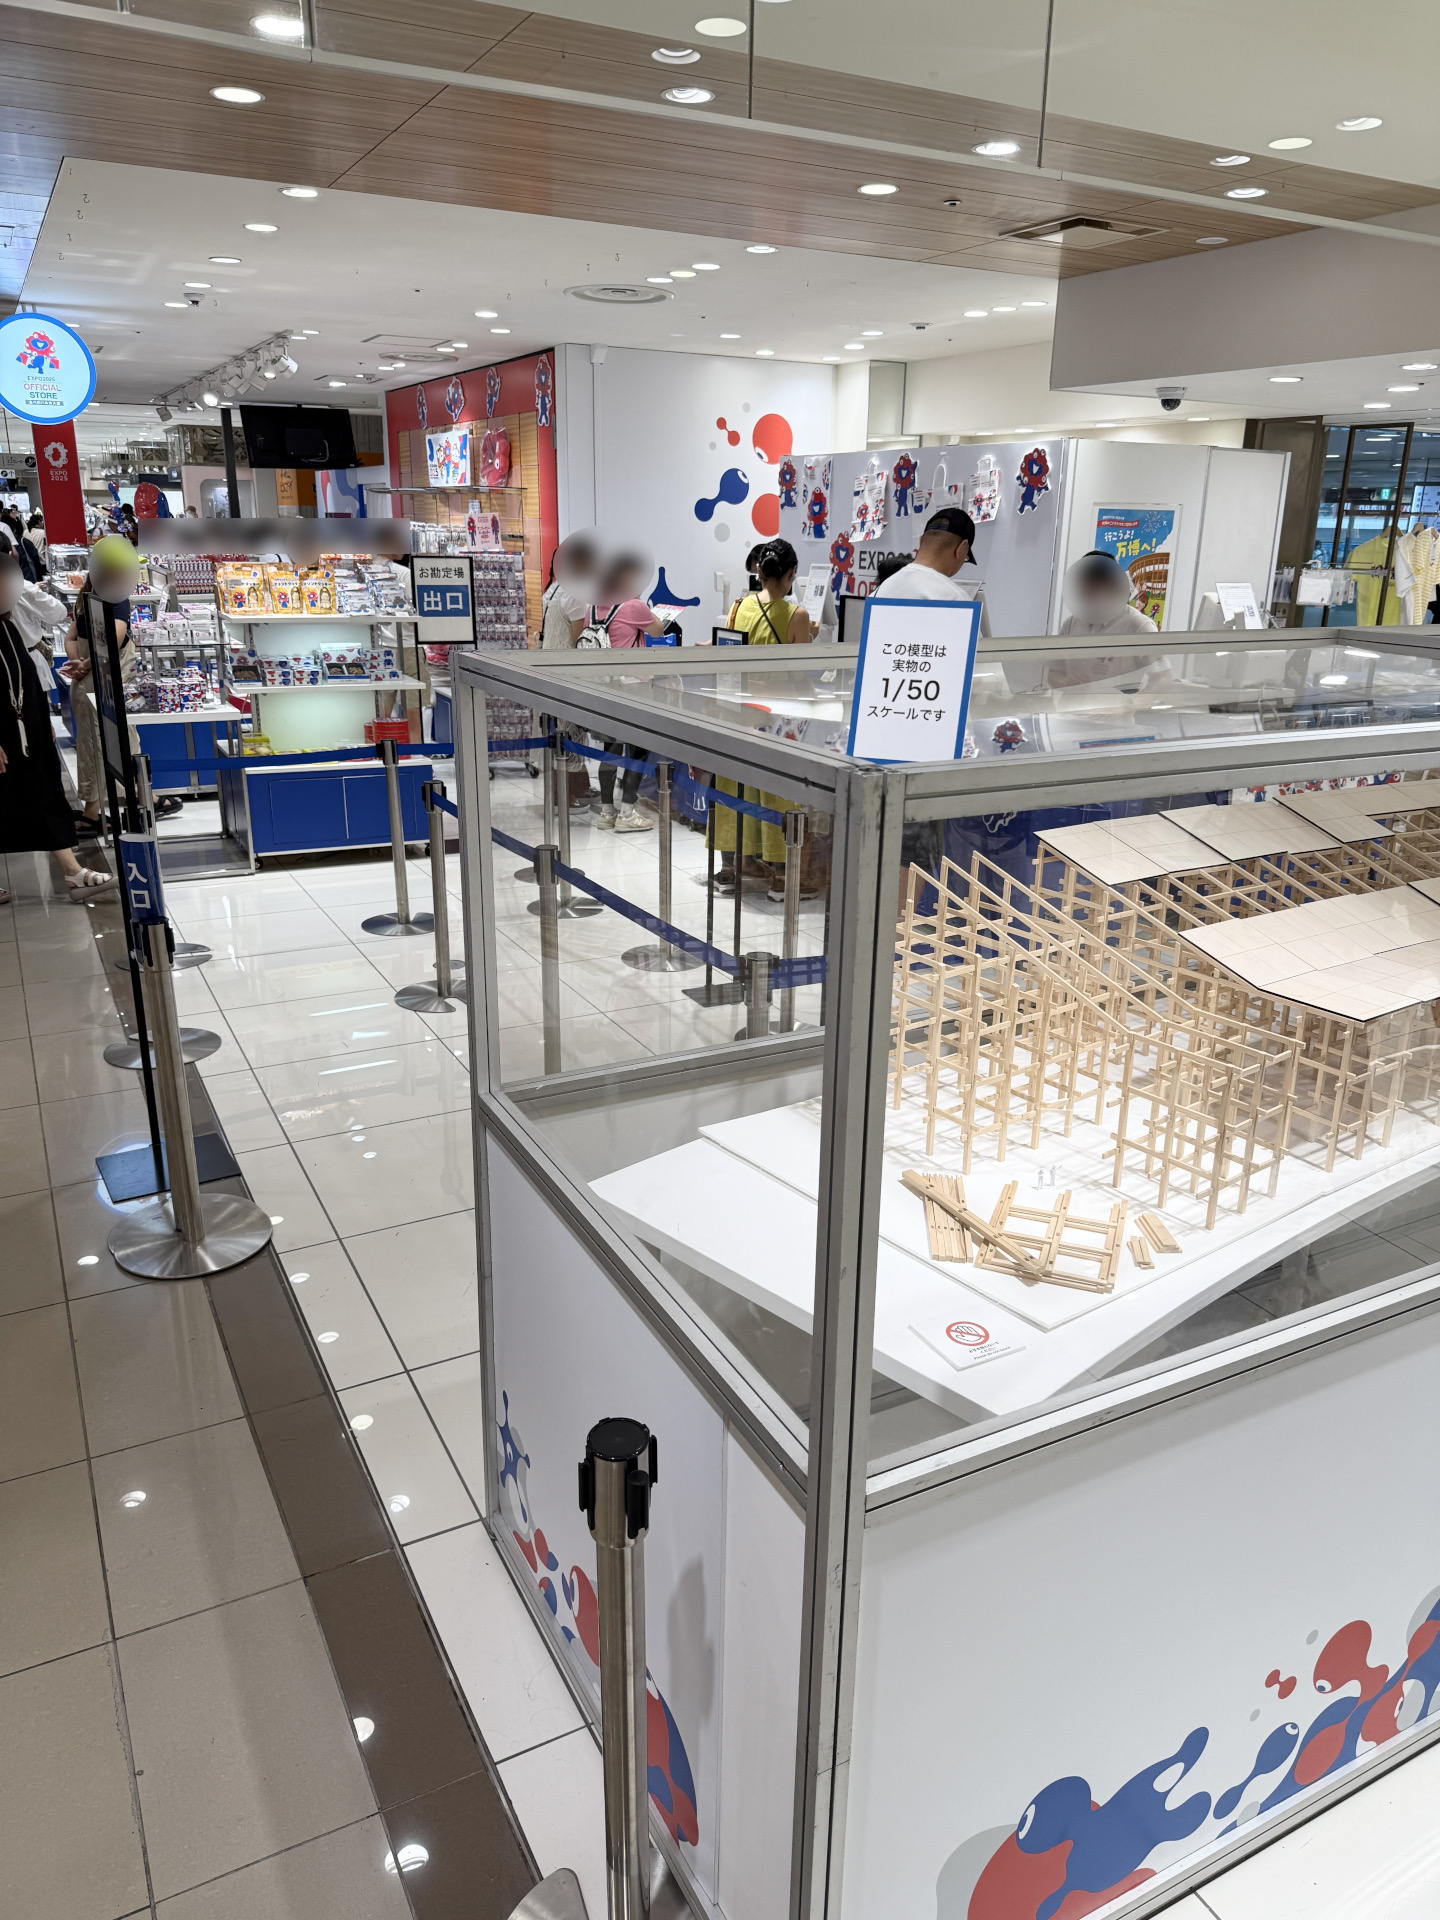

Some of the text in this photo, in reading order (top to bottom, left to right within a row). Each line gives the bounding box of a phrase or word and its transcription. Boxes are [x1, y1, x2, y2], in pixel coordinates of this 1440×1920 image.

[24, 383, 62, 391] OFFICIAL
[1116, 538, 1157, 558] 万博へ!
[418, 566, 465, 579] お勘定場
[423, 590, 464, 612] 出口
[882, 643, 947, 658] この模型は
[892, 659, 932, 673] 実物の
[882, 677, 941, 703] 1/50
[867, 705, 946, 722] スケールです
[127, 862, 152, 909] 入口
